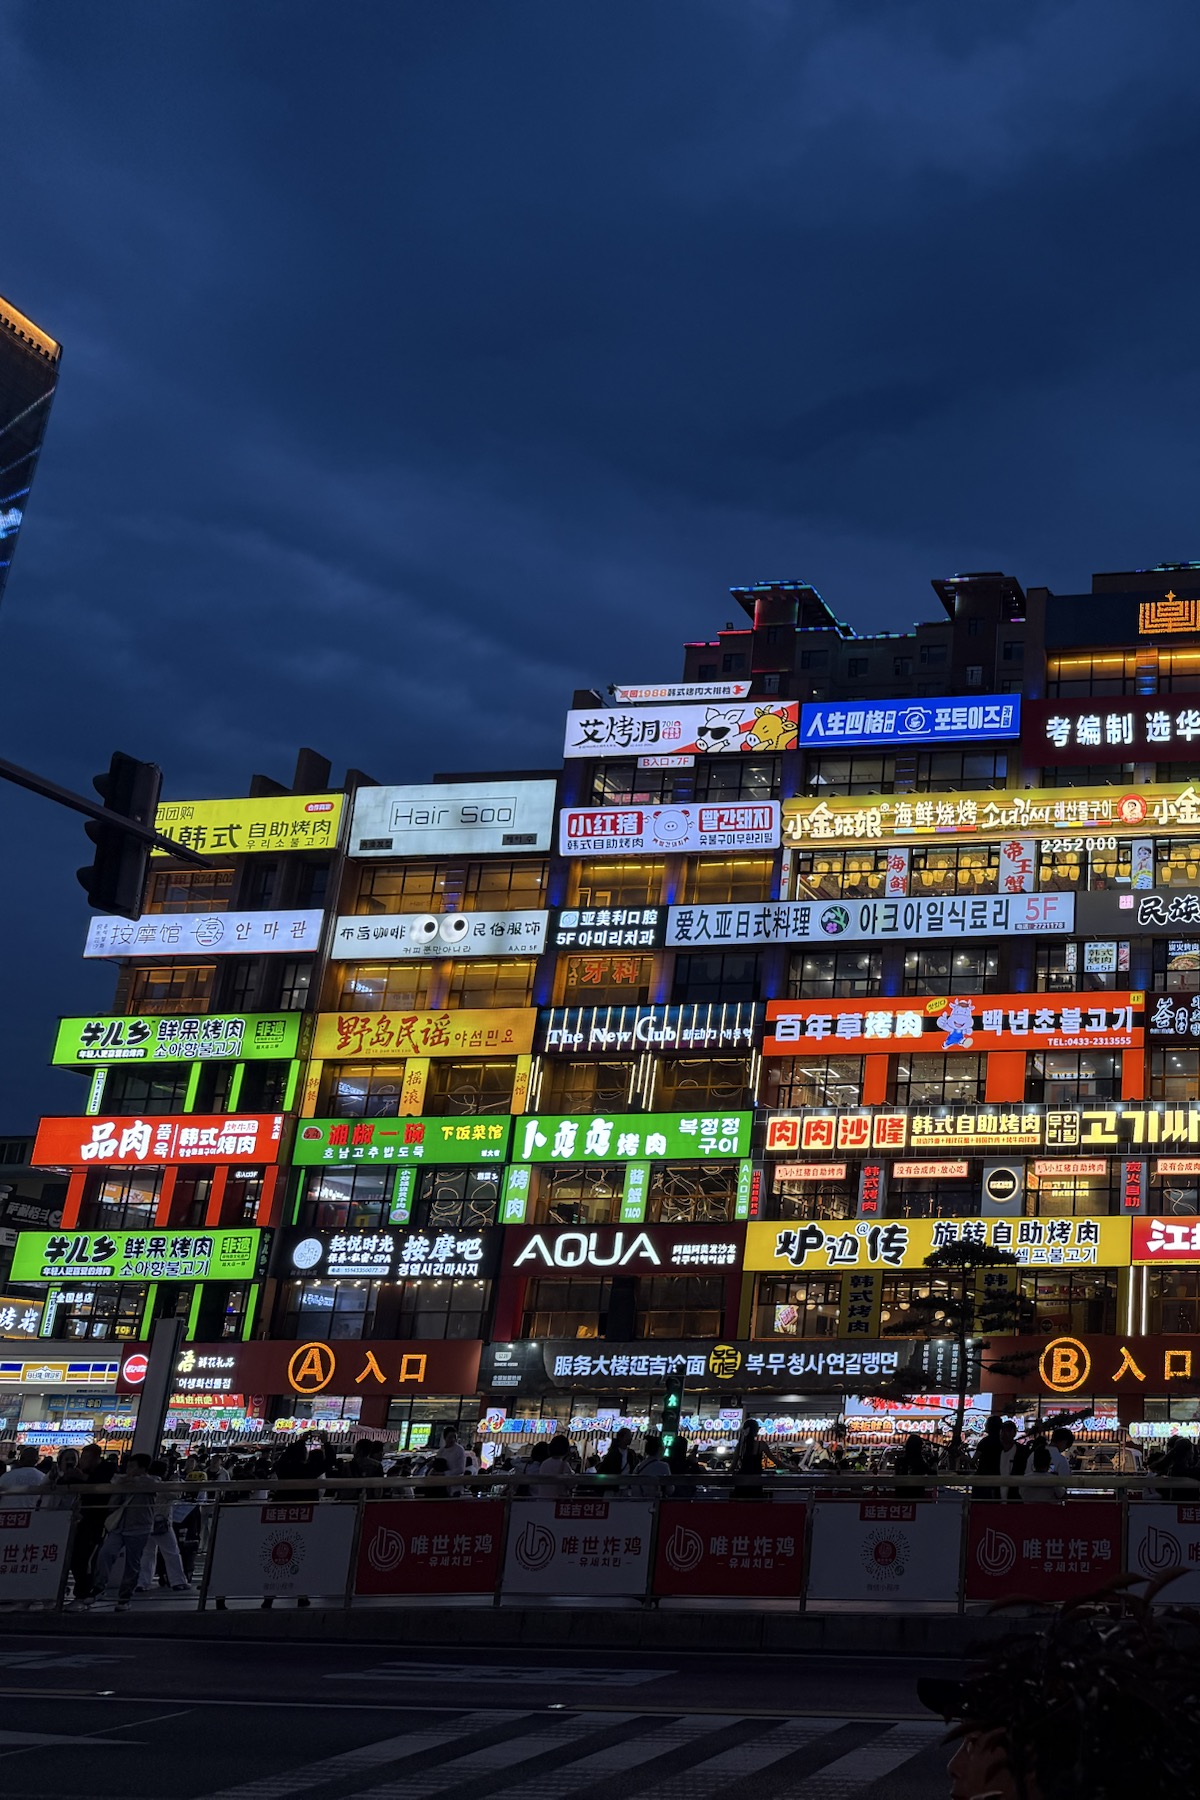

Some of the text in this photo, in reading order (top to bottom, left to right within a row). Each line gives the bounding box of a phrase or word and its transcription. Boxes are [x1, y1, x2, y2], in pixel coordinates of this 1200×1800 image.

[806, 710, 884, 737] 人生四格
[934, 705, 1000, 731] 포토이즈
[1046, 712, 1133, 748] 考编制
[394, 804, 513, 826] Hair Soo
[701, 807, 770, 831] 빨간돼지
[786, 801, 883, 839] 小金姑娘
[894, 799, 978, 828] 海鲜烧烤
[1054, 798, 1112, 822] 해산물구이
[249, 819, 332, 839] 自助烤肉
[569, 812, 640, 837] 小红猪
[567, 837, 644, 851] 韩式自助烤肉
[1041, 836, 1118, 854] 2252000
[886, 854, 908, 890] 海鲜
[1001, 839, 1034, 893] 帝王蟹
[580, 909, 659, 927] 亚美利口腔
[859, 898, 1011, 936] 아크아일식료리
[1024, 896, 1060, 923] 5F
[110, 922, 184, 947] 按摩馆
[234, 919, 309, 943] 안마관
[472, 921, 542, 938] 民俗服饰
[674, 906, 812, 942] 爱久亚日式料理
[556, 929, 656, 947] 5F 아미리치과
[580, 959, 639, 985] 牙科
[156, 1018, 246, 1041] 鲜果烤肉
[548, 1016, 677, 1044] The New Club
[774, 1010, 924, 1042] 百年草烤肉
[981, 1005, 1134, 1038] 백년초불고기
[336, 1013, 452, 1056] 野岛民谣
[454, 1029, 515, 1048] 야섬민요
[152, 1039, 243, 1059] 소아향불고기
[514, 1071, 528, 1096] 酒馆
[178, 1126, 218, 1148] 韩式
[327, 1122, 427, 1146] 湘椒一碗
[441, 1124, 504, 1142] 下饭菜馆
[678, 1116, 741, 1135] 복정정
[768, 1118, 906, 1147] 肉肉沙隆
[911, 1114, 1042, 1136] 韩式自助烤肉
[80, 1118, 153, 1161] 品肉
[214, 1135, 257, 1156] 烤肉
[616, 1131, 668, 1157] 烤肉
[698, 1136, 739, 1155] 구이
[322, 1145, 426, 1160] 호남고추밥도둑
[505, 1169, 530, 1219] 烤肉
[932, 1219, 1100, 1247] 旋转自助烤肉
[123, 1235, 214, 1260] 鲜果烤肉
[329, 1233, 484, 1263] 轻悦时光 按摩吧
[512, 1231, 662, 1268] AQUA
[118, 1260, 210, 1278] 소아향불고기
[56, 1291, 95, 1304] 全国总店
[354, 1349, 428, 1385] 入口
[553, 1354, 708, 1378] 服务大楼延吉冷面
[744, 1351, 899, 1377] 복무청사연길랭면
[1111, 1346, 1193, 1382] 入口
[3, 1543, 58, 1563] 世炸鸡
[410, 1534, 494, 1556] 唯世炸鸡
[561, 1535, 642, 1556] 唯世炸鸡
[709, 1535, 796, 1557] 唯世炸鸡
[1021, 1538, 1112, 1561] 唯世炸鸡
[0, 1563, 39, 1576] 유세치킨
[428, 1556, 472, 1567] 유세치킨
[578, 1556, 621, 1568] 유세치킨
[728, 1557, 774, 1569] 유세치킨
[1042, 1561, 1090, 1573] 유세치킨
